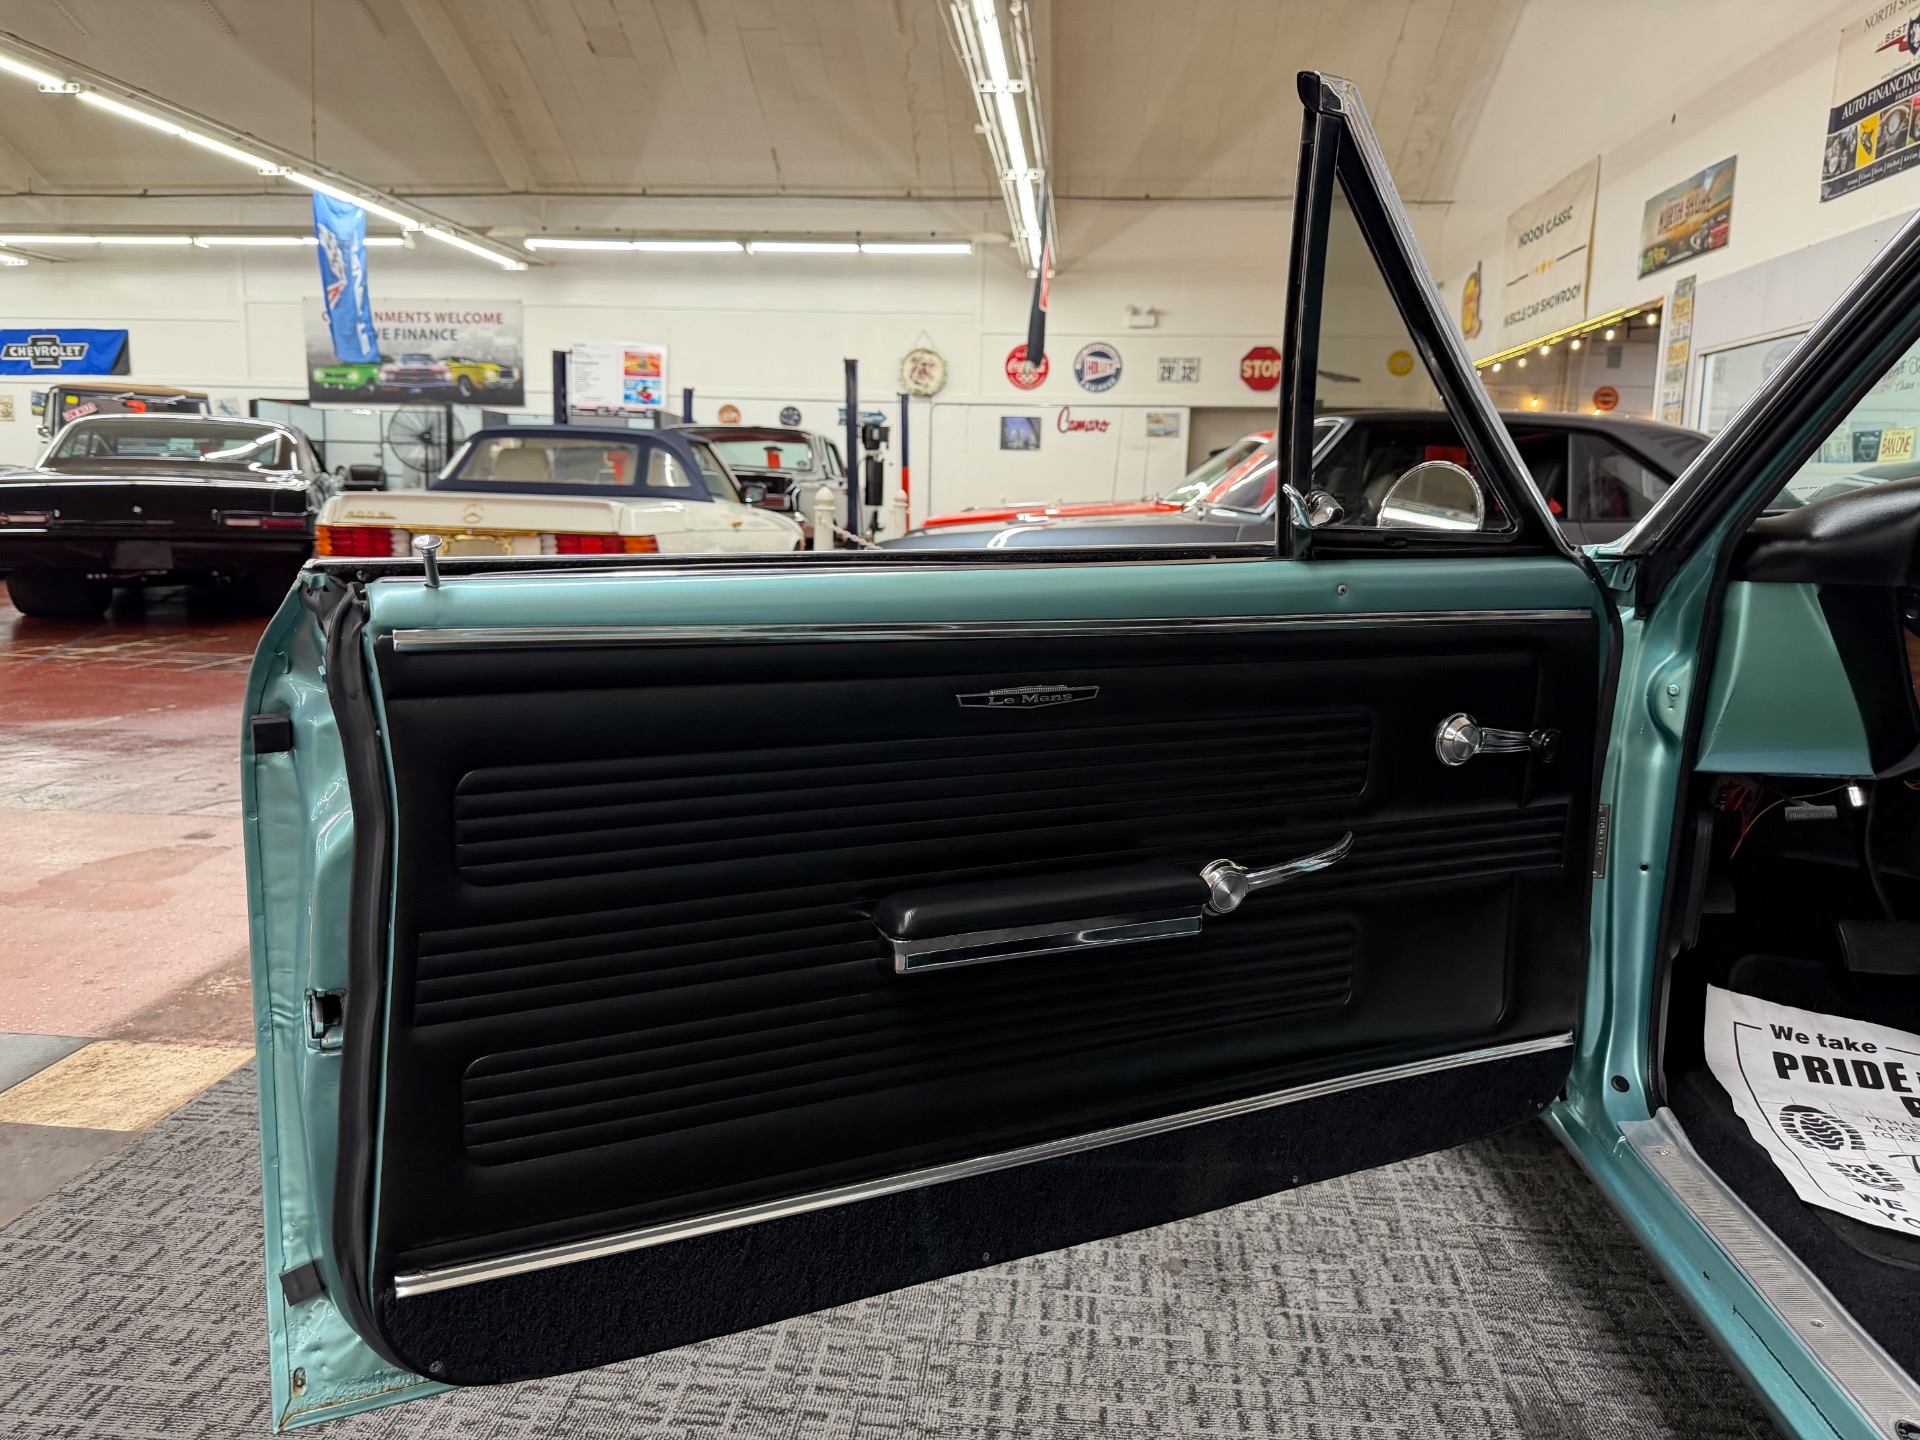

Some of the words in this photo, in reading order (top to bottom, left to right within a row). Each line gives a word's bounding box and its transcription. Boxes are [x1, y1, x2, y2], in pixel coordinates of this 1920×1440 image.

[1864, 0, 1897, 32] NORTH
[1885, 23, 1907, 43] BEST
[1842, 96, 1867, 119] AUTO
[1867, 67, 1920, 107] FINANCING
[1545, 205, 1573, 234] CLASSIC
[434, 312, 504, 325] WELCOME
[394, 328, 459, 341] FINANCE
[9, 346, 81, 357] CHEVROLET
[1241, 359, 1281, 378] STOP
[1057, 406, 1111, 433] Camaro
[988, 696, 1015, 706] Le
[1021, 693, 1073, 705] Mans
[1769, 1023, 1810, 1044] We
[1816, 1033, 1878, 1054] take
[1772, 1050, 1914, 1094] PRIDE
[1868, 1130, 1895, 1139] TO
[1888, 1126, 1920, 1136] PLE
[1852, 1190, 1909, 1213] WE
[1873, 1207, 1920, 1229] YO
